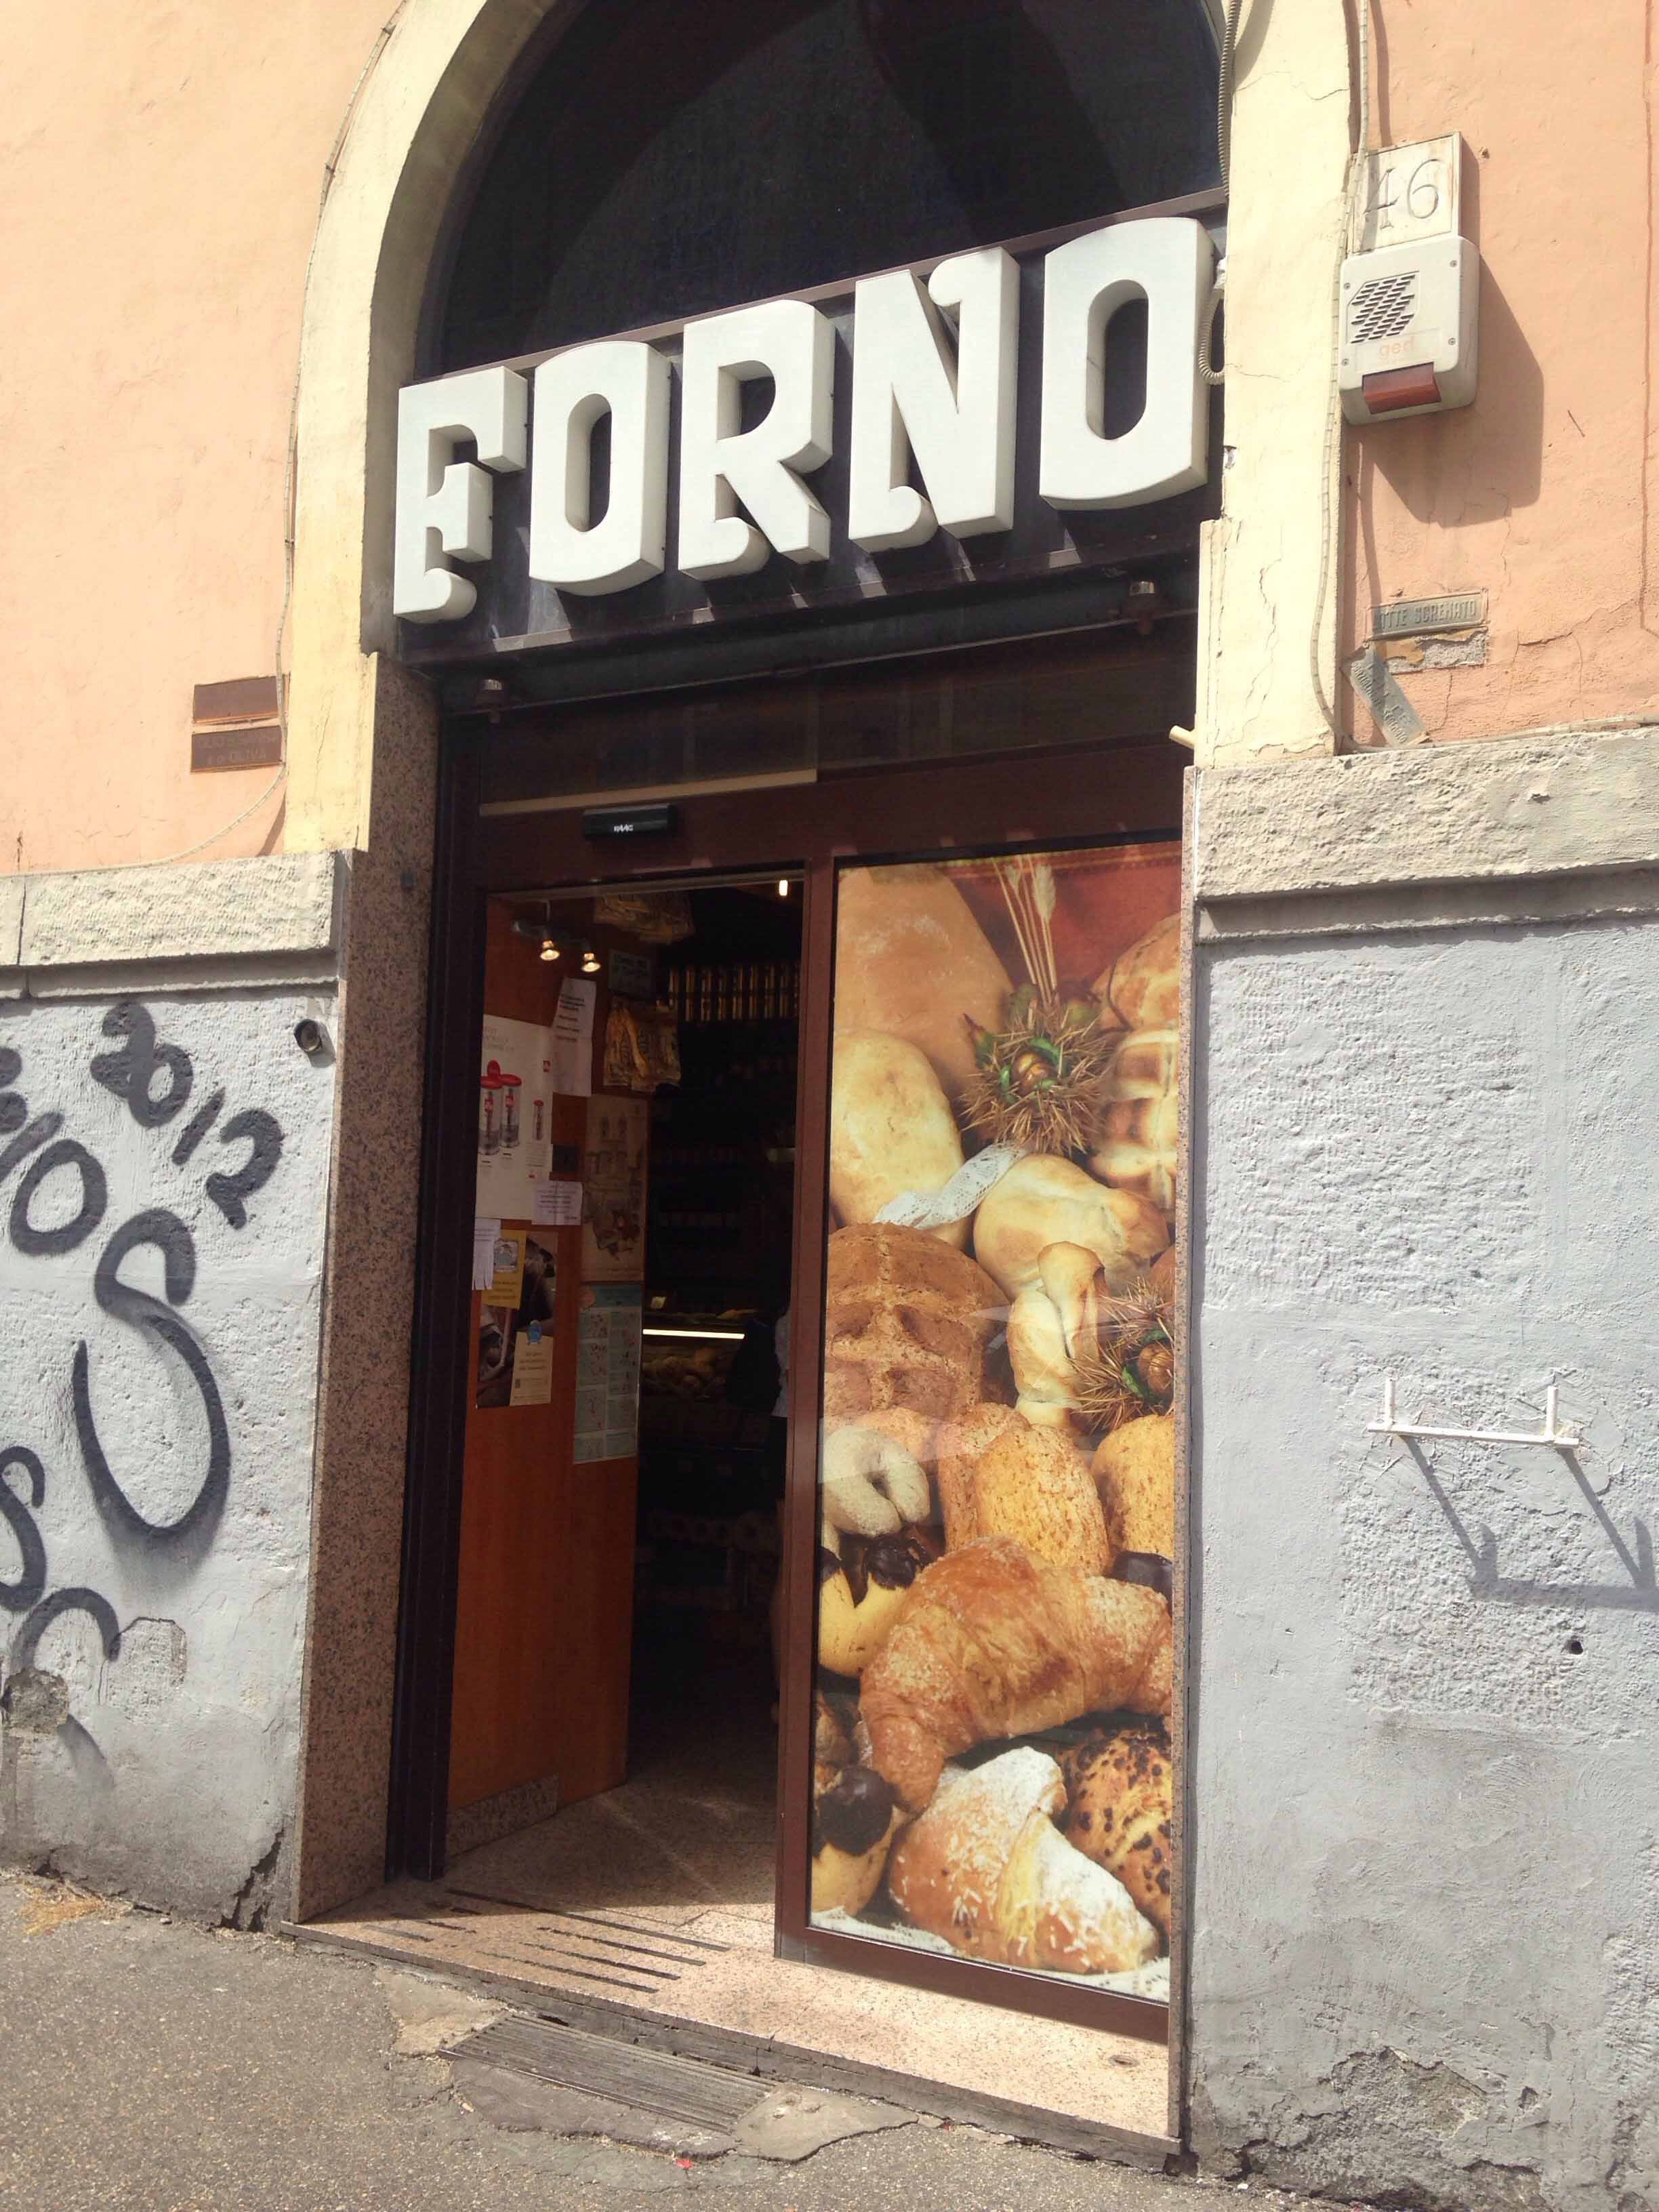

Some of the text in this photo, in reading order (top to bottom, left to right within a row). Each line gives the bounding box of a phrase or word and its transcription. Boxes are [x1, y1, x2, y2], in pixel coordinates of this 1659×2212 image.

[1363, 158, 1443, 230] 46
[393, 216, 1214, 623] FORNO
[1415, 599, 1477, 624] SCREMATO
